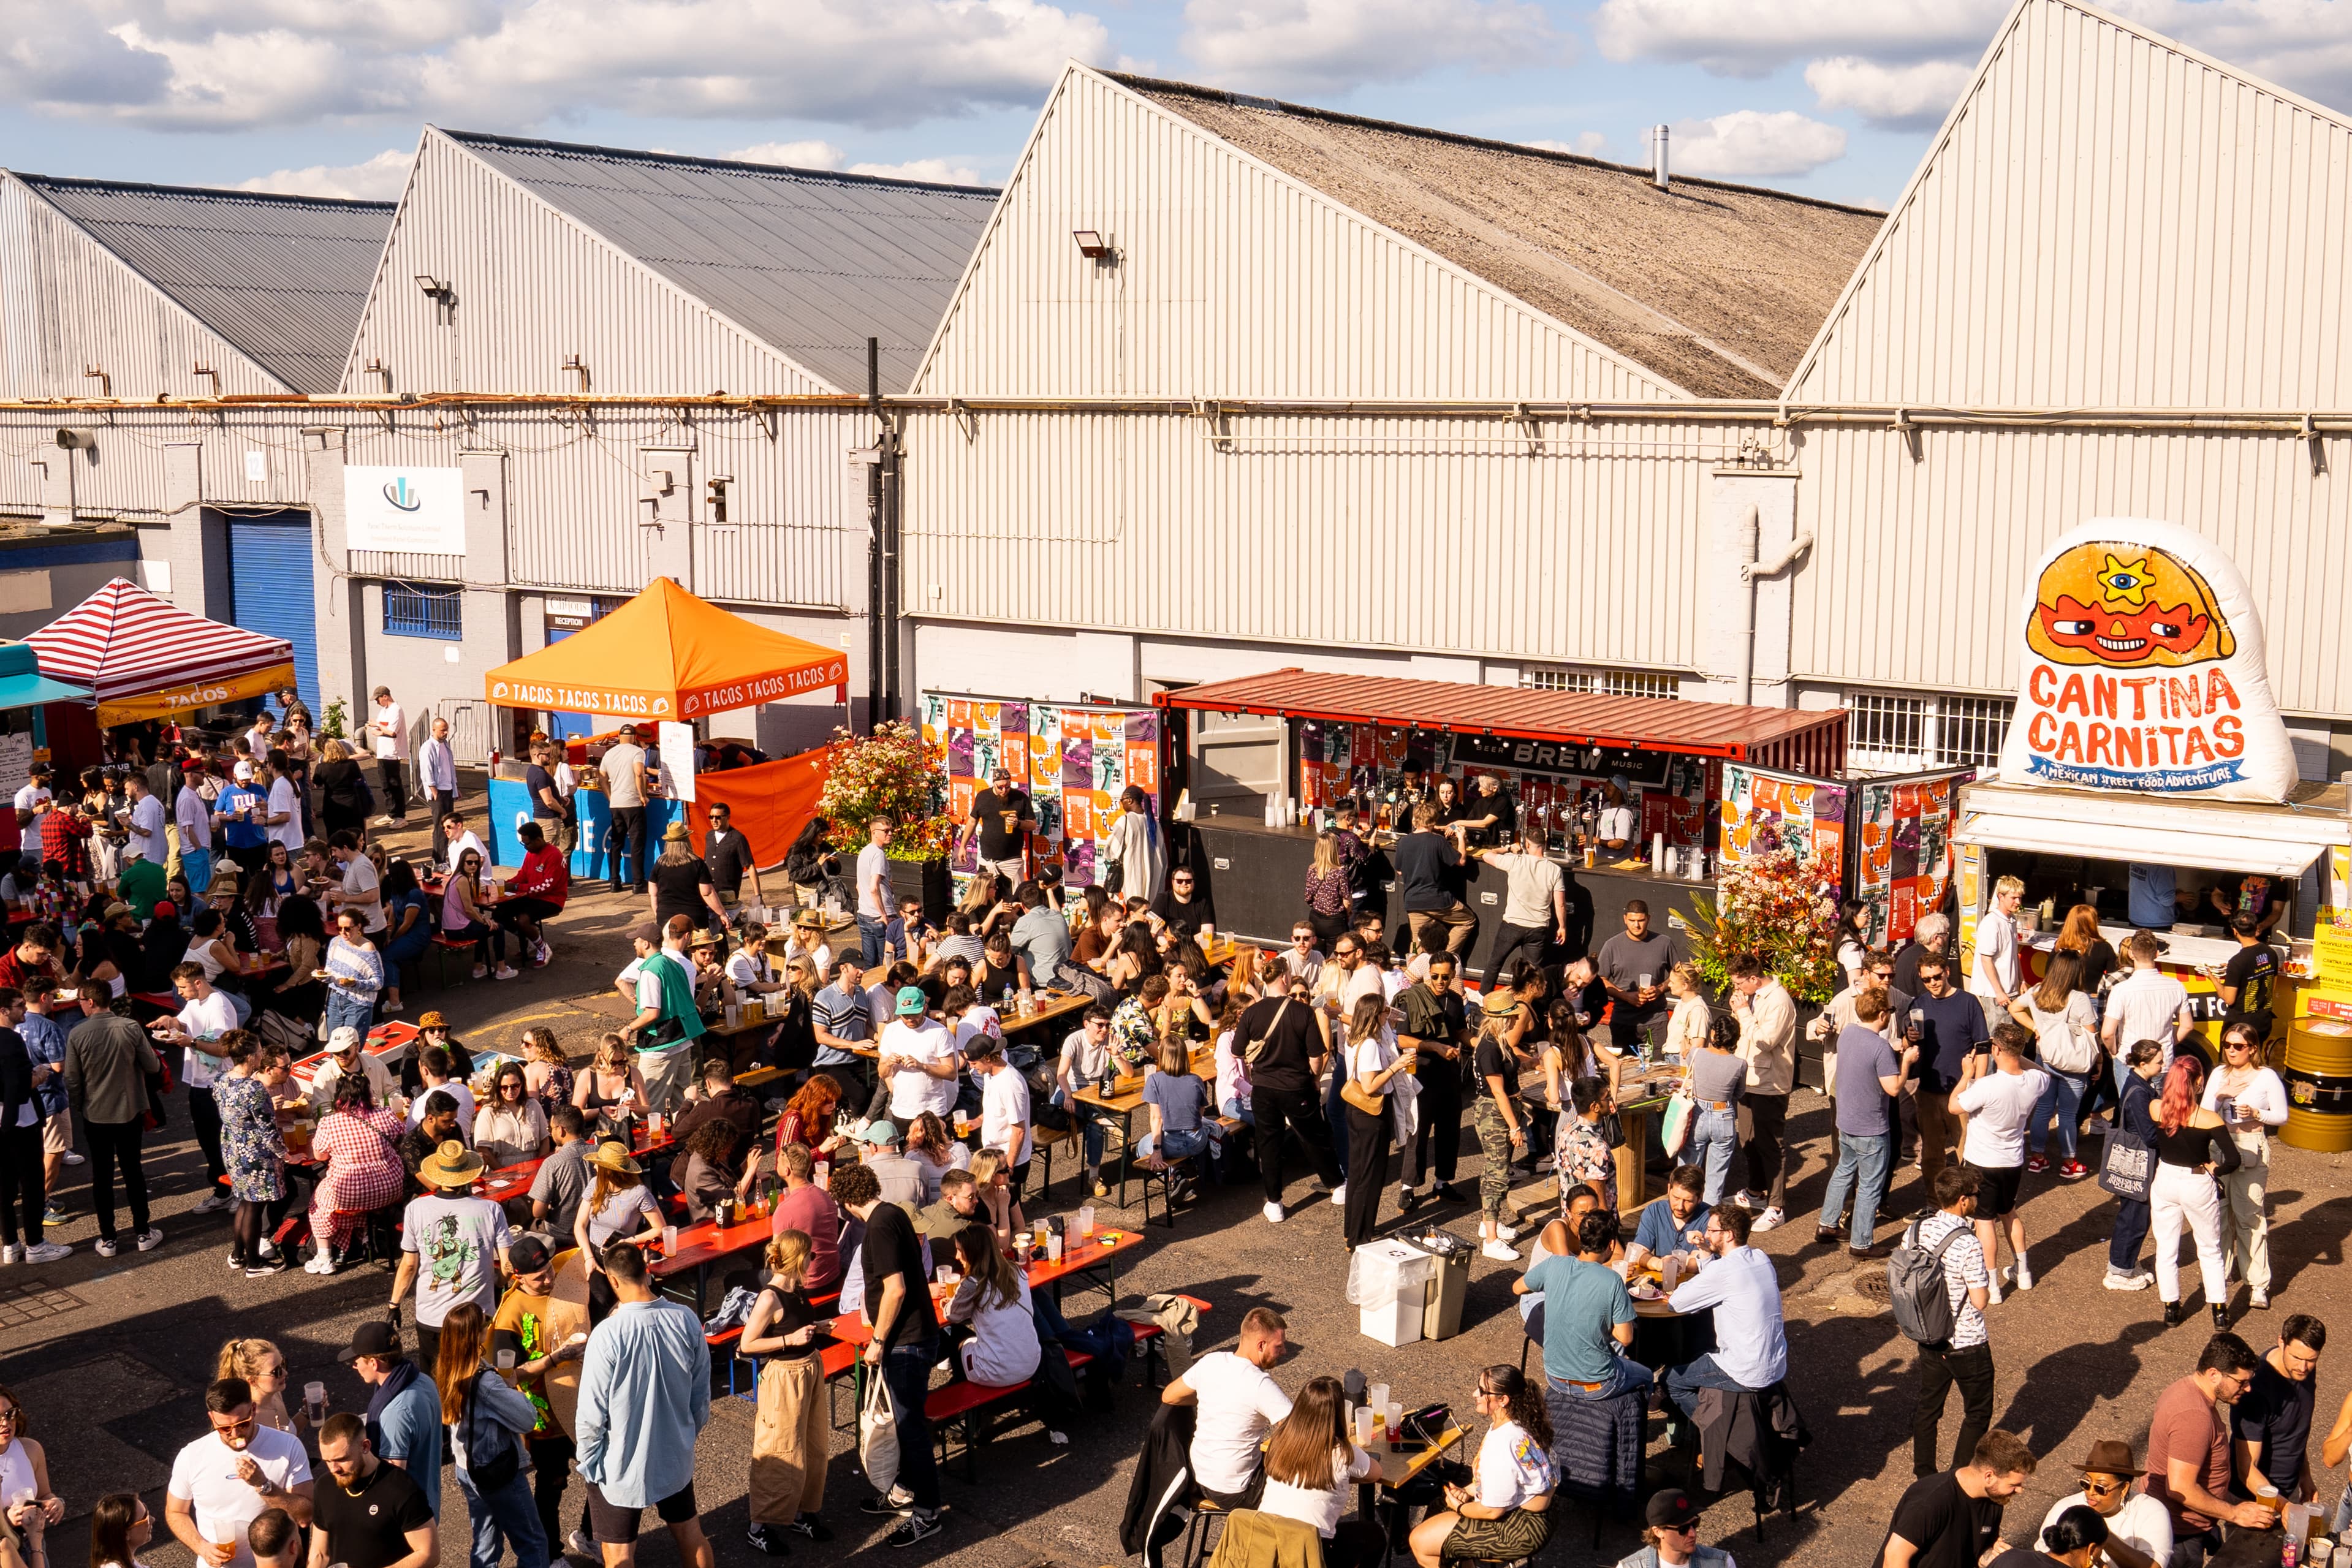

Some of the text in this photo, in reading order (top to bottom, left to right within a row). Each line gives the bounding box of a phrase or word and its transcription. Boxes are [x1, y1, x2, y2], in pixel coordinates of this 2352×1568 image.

[555, 616, 583, 626] RECEPTION
[704, 667, 825, 709] TACOS TACOS TACOS
[165, 686, 229, 710] TACOS
[513, 684, 647, 713] TACOS TACOS TACOS
[974, 737, 999, 747] UNSUNG
[1093, 748, 1122, 757] UNSUNG
[1476, 744, 1504, 754] BEER
[1514, 743, 1603, 770] BREW
[1611, 760, 1643, 770] MUSIC
[2101, 771, 2133, 788] STREET
[2138, 775, 2164, 789] FOOD
[2165, 767, 2232, 788] ADVENTURE
[1032, 793, 1060, 803] UNSUNG
[2206, 996, 2228, 1018] FO
[1104, 1080, 1114, 1091] 30
